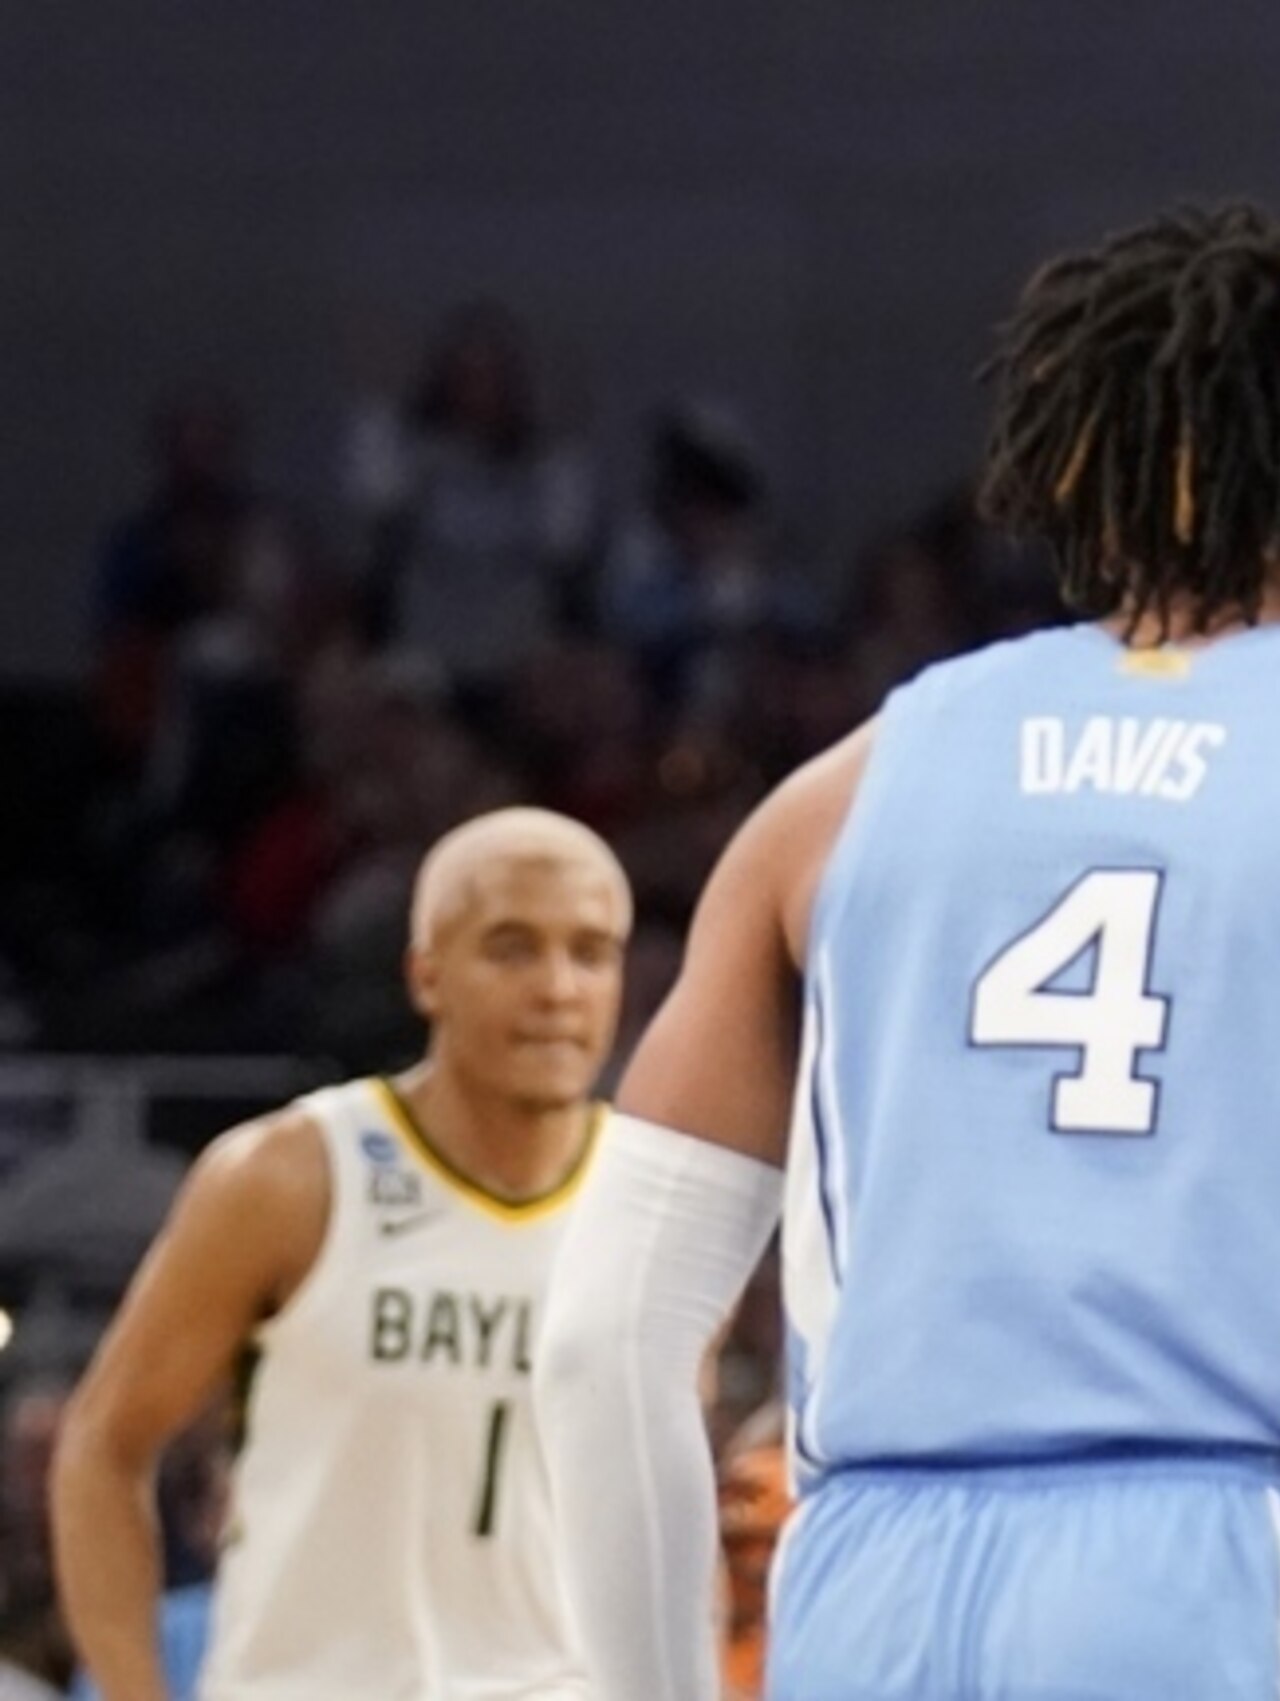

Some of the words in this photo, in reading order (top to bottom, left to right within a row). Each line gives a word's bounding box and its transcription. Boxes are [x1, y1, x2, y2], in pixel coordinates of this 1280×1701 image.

[1020, 715, 1226, 801] DAVIS
[967, 866, 1172, 1136] 4
[473, 1402, 508, 1538] 1
